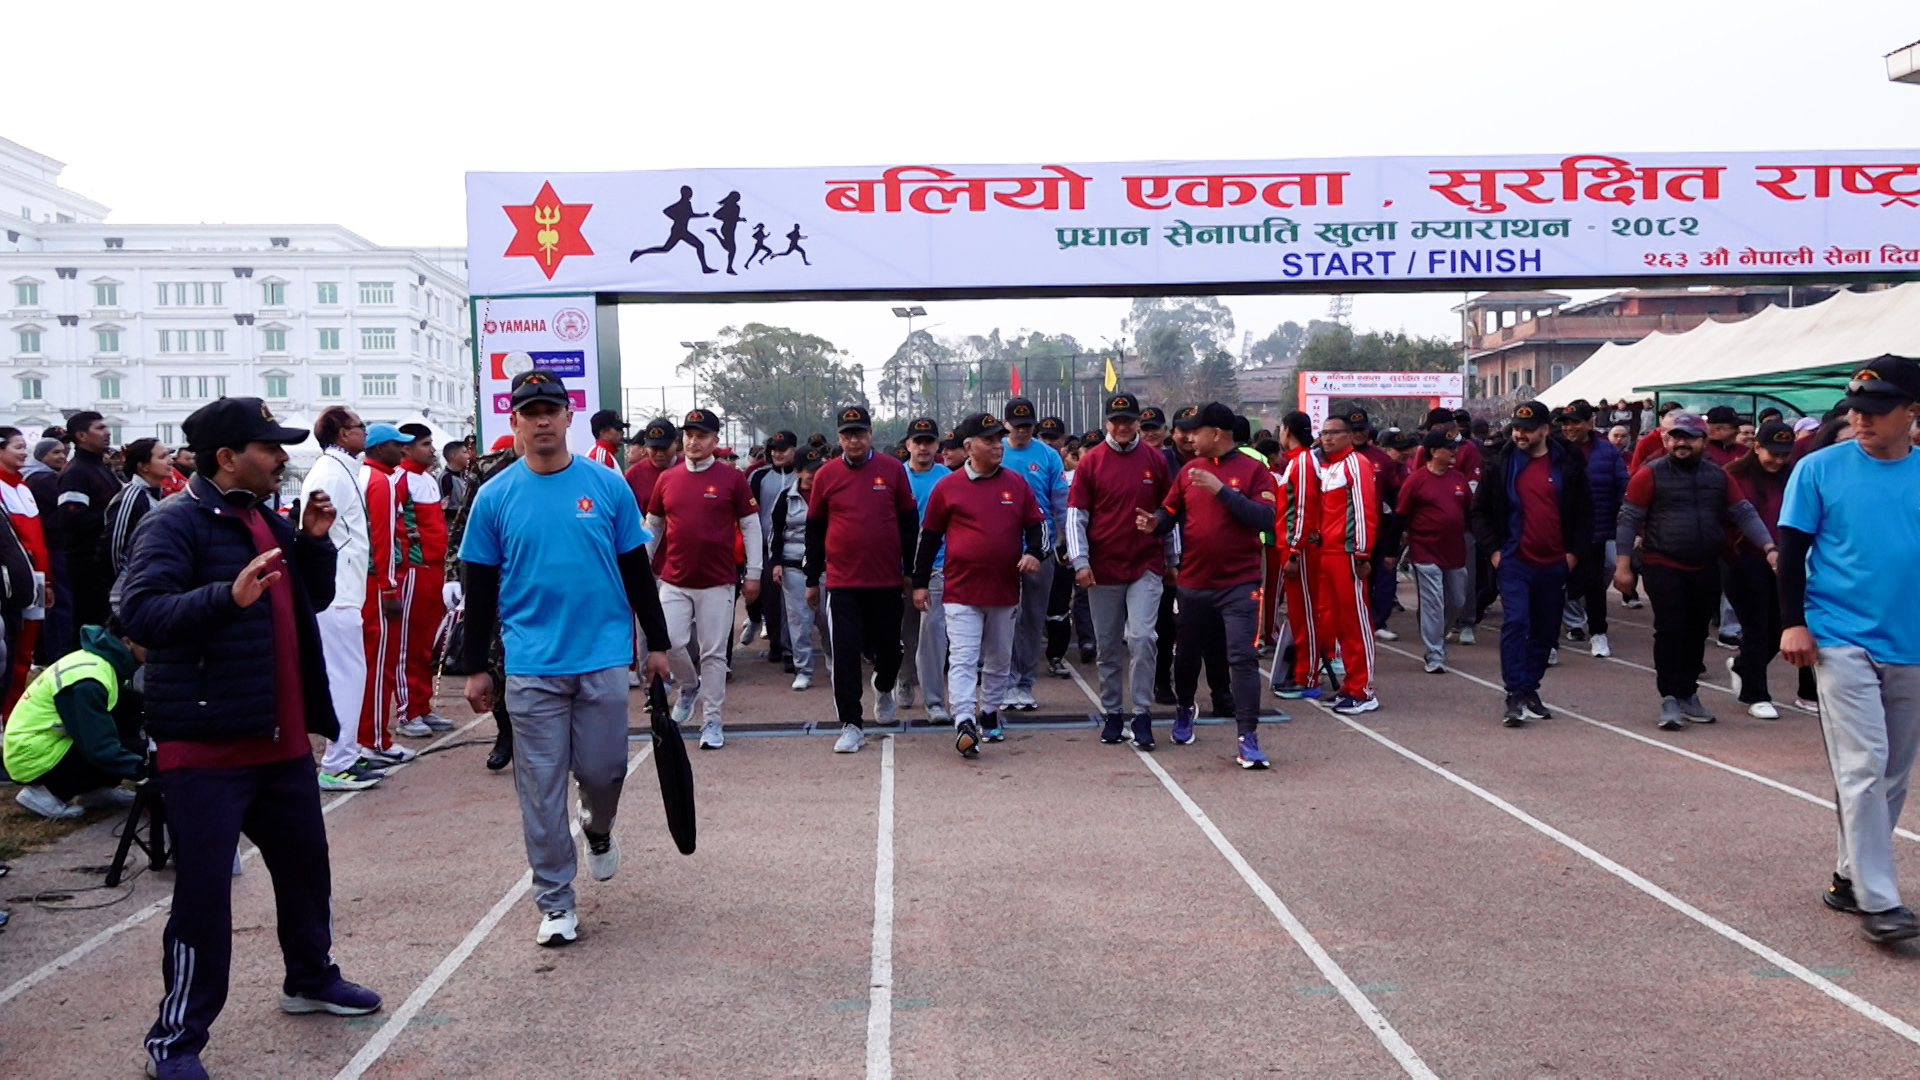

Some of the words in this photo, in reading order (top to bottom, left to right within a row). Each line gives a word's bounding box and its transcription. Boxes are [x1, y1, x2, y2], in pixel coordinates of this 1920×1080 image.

[825, 165, 1093, 214] बलियो
[1121, 172, 1351, 210] एकता
[1428, 155, 1727, 213] सुरक्षित
[1755, 163, 1920, 208] राष्ट्र
[1055, 227, 1150, 250] प्रधान
[1163, 216, 1302, 248] सेनापति
[1314, 221, 1399, 248] खुला
[1411, 218, 1572, 240] म्याराथन
[1611, 217, 1700, 237] २०८२
[1282, 250, 1397, 278] START
[1428, 248, 1542, 274] FINISH
[1643, 252, 1689, 268] २६३
[1738, 245, 1815, 265] नेपाली
[1823, 245, 1872, 265] सेना
[499, 319, 547, 332] YAMAHA
